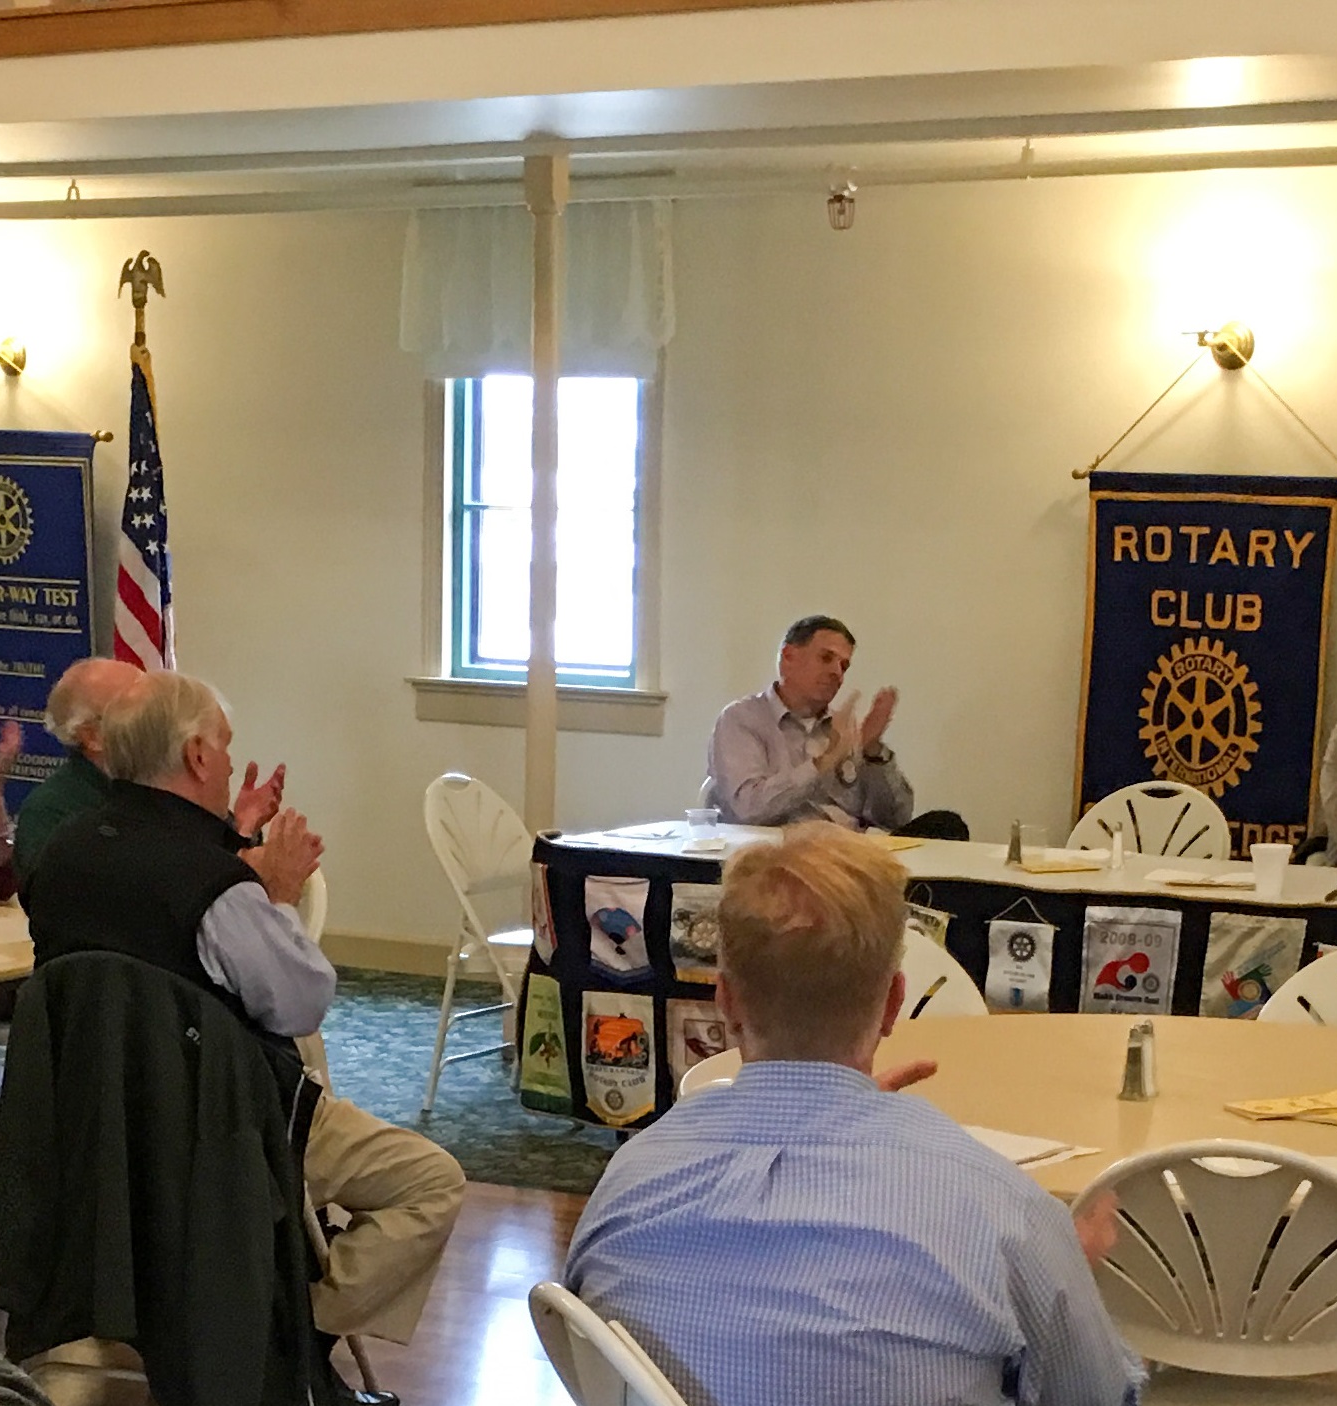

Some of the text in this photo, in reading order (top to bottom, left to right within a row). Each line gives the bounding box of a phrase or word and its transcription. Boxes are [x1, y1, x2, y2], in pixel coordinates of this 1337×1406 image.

[1113, 525, 1315, 569] ROTARY
[43, 588, 79, 607] TEST
[1150, 589, 1263, 632] CLUB
[1173, 655, 1235, 682] ROTARY
[1099, 931, 1162, 948] 2008-09
